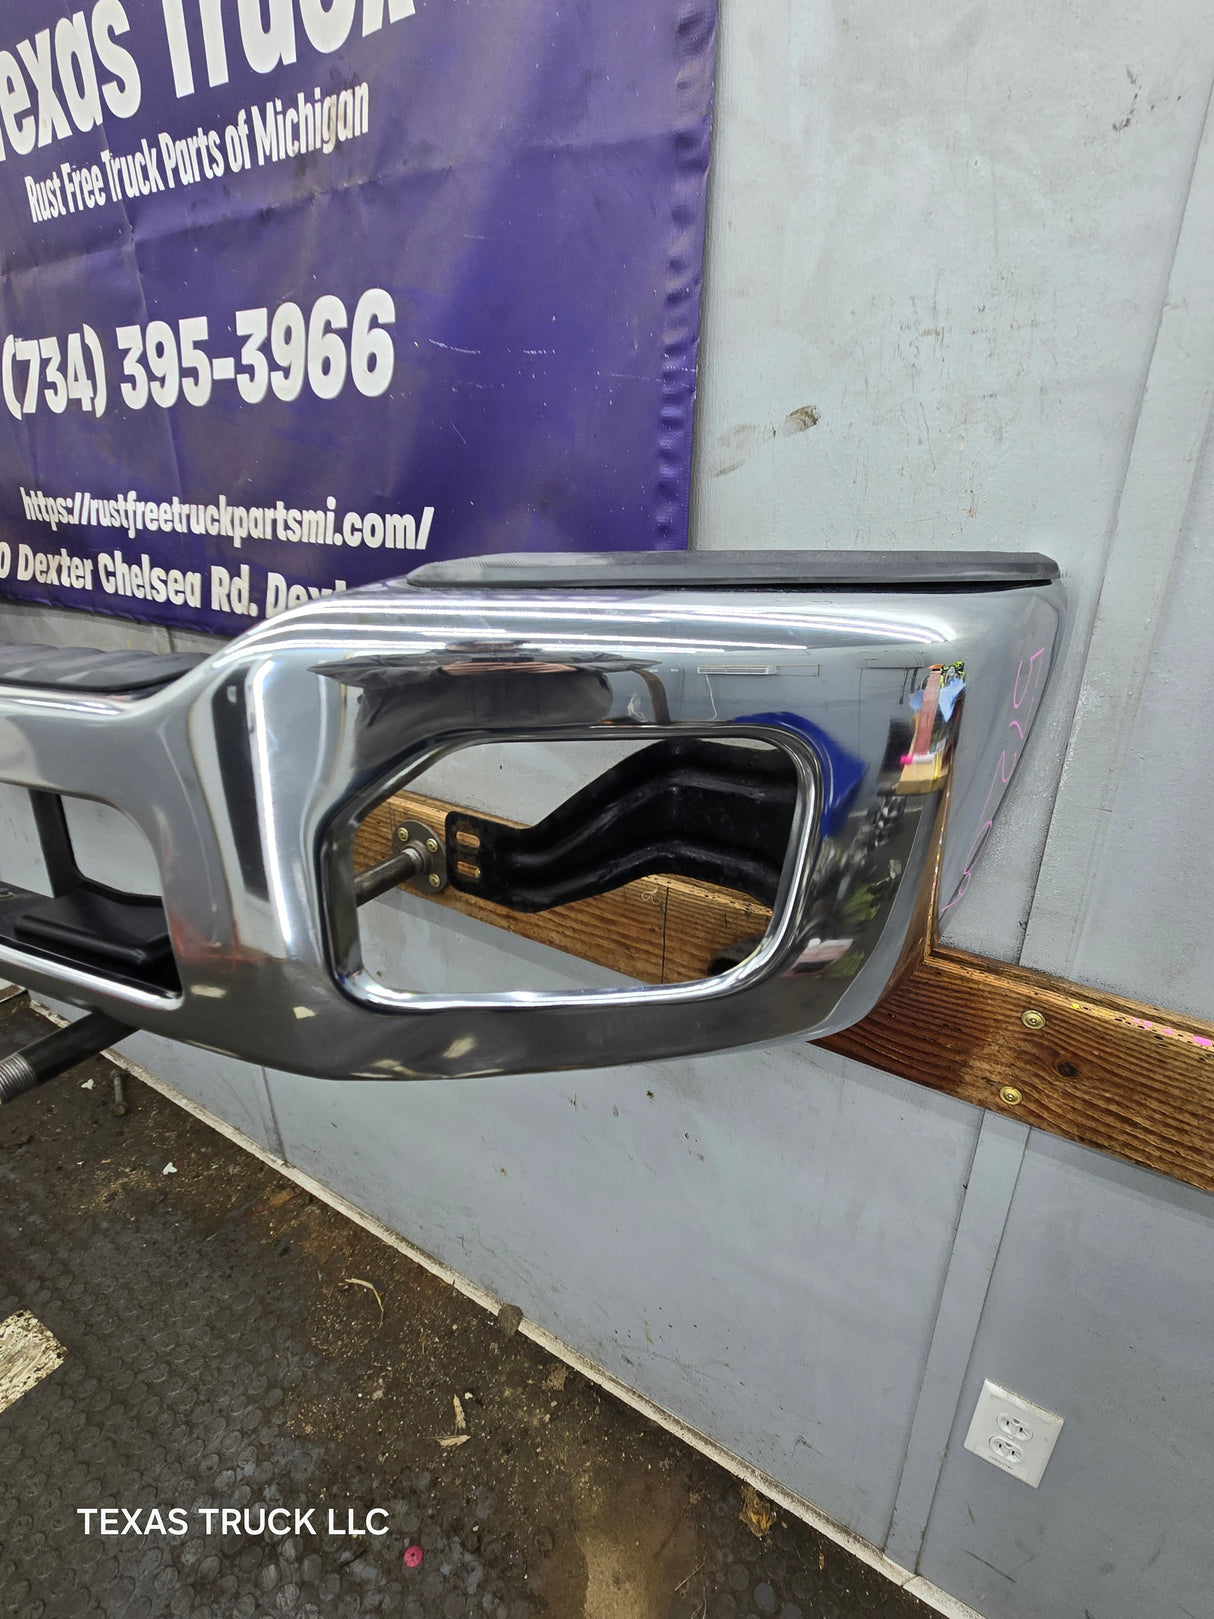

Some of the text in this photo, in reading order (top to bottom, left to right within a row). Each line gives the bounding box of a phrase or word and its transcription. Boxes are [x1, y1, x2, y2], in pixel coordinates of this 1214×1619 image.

[0, 0, 141, 161] exas
[24, 81, 369, 223] Rust Free Truck Parts of Michigan
[2, 288, 396, 420] (734) 395-3966
[17, 544, 94, 591] Dexter
[98, 550, 202, 608] Chelsea
[211, 564, 259, 617] Rd.
[20, 487, 435, 550] https://rustfreetruckpartsmi.com/
